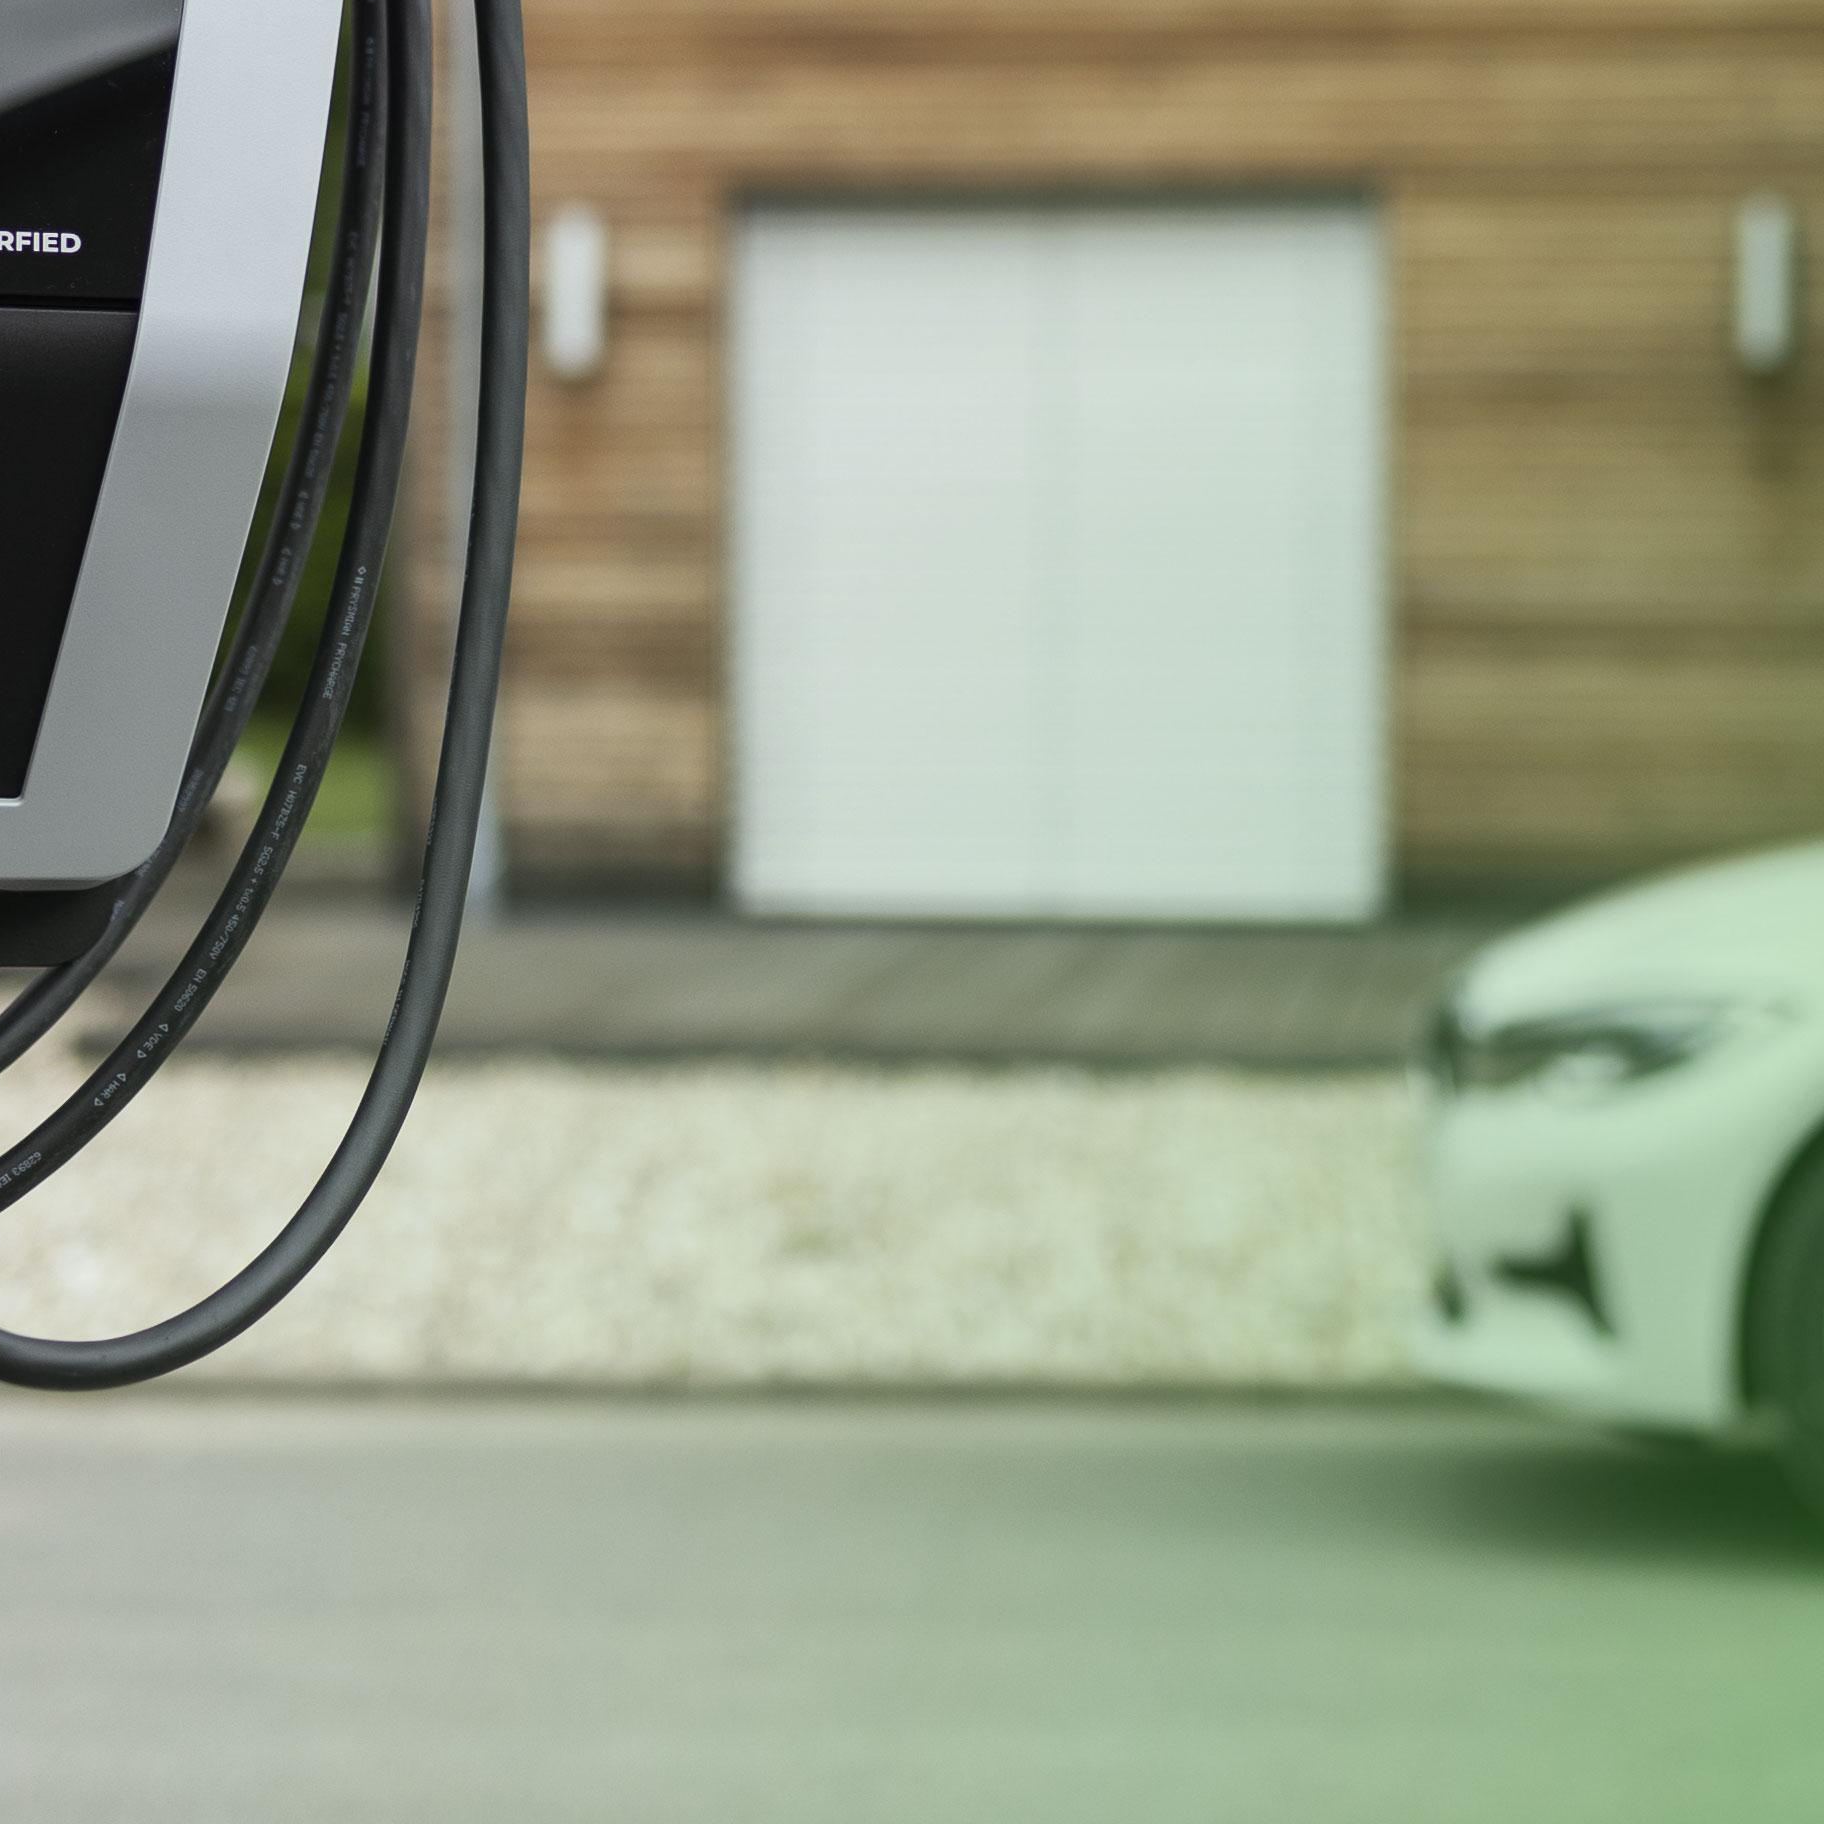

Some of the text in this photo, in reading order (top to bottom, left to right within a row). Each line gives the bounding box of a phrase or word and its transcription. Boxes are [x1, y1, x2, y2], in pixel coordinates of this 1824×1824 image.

[322, 585, 362, 701] PRYSMIAN PRYCHARGE
[292, 763, 307, 785] EVC
[207, 912, 241, 961] 450/750V
[192, 967, 208, 984] EN
[173, 982, 198, 1013] 50620
[142, 1030, 163, 1053] VDE
[99, 1079, 121, 1100] HAR
[10, 1150, 44, 1178] 62893
